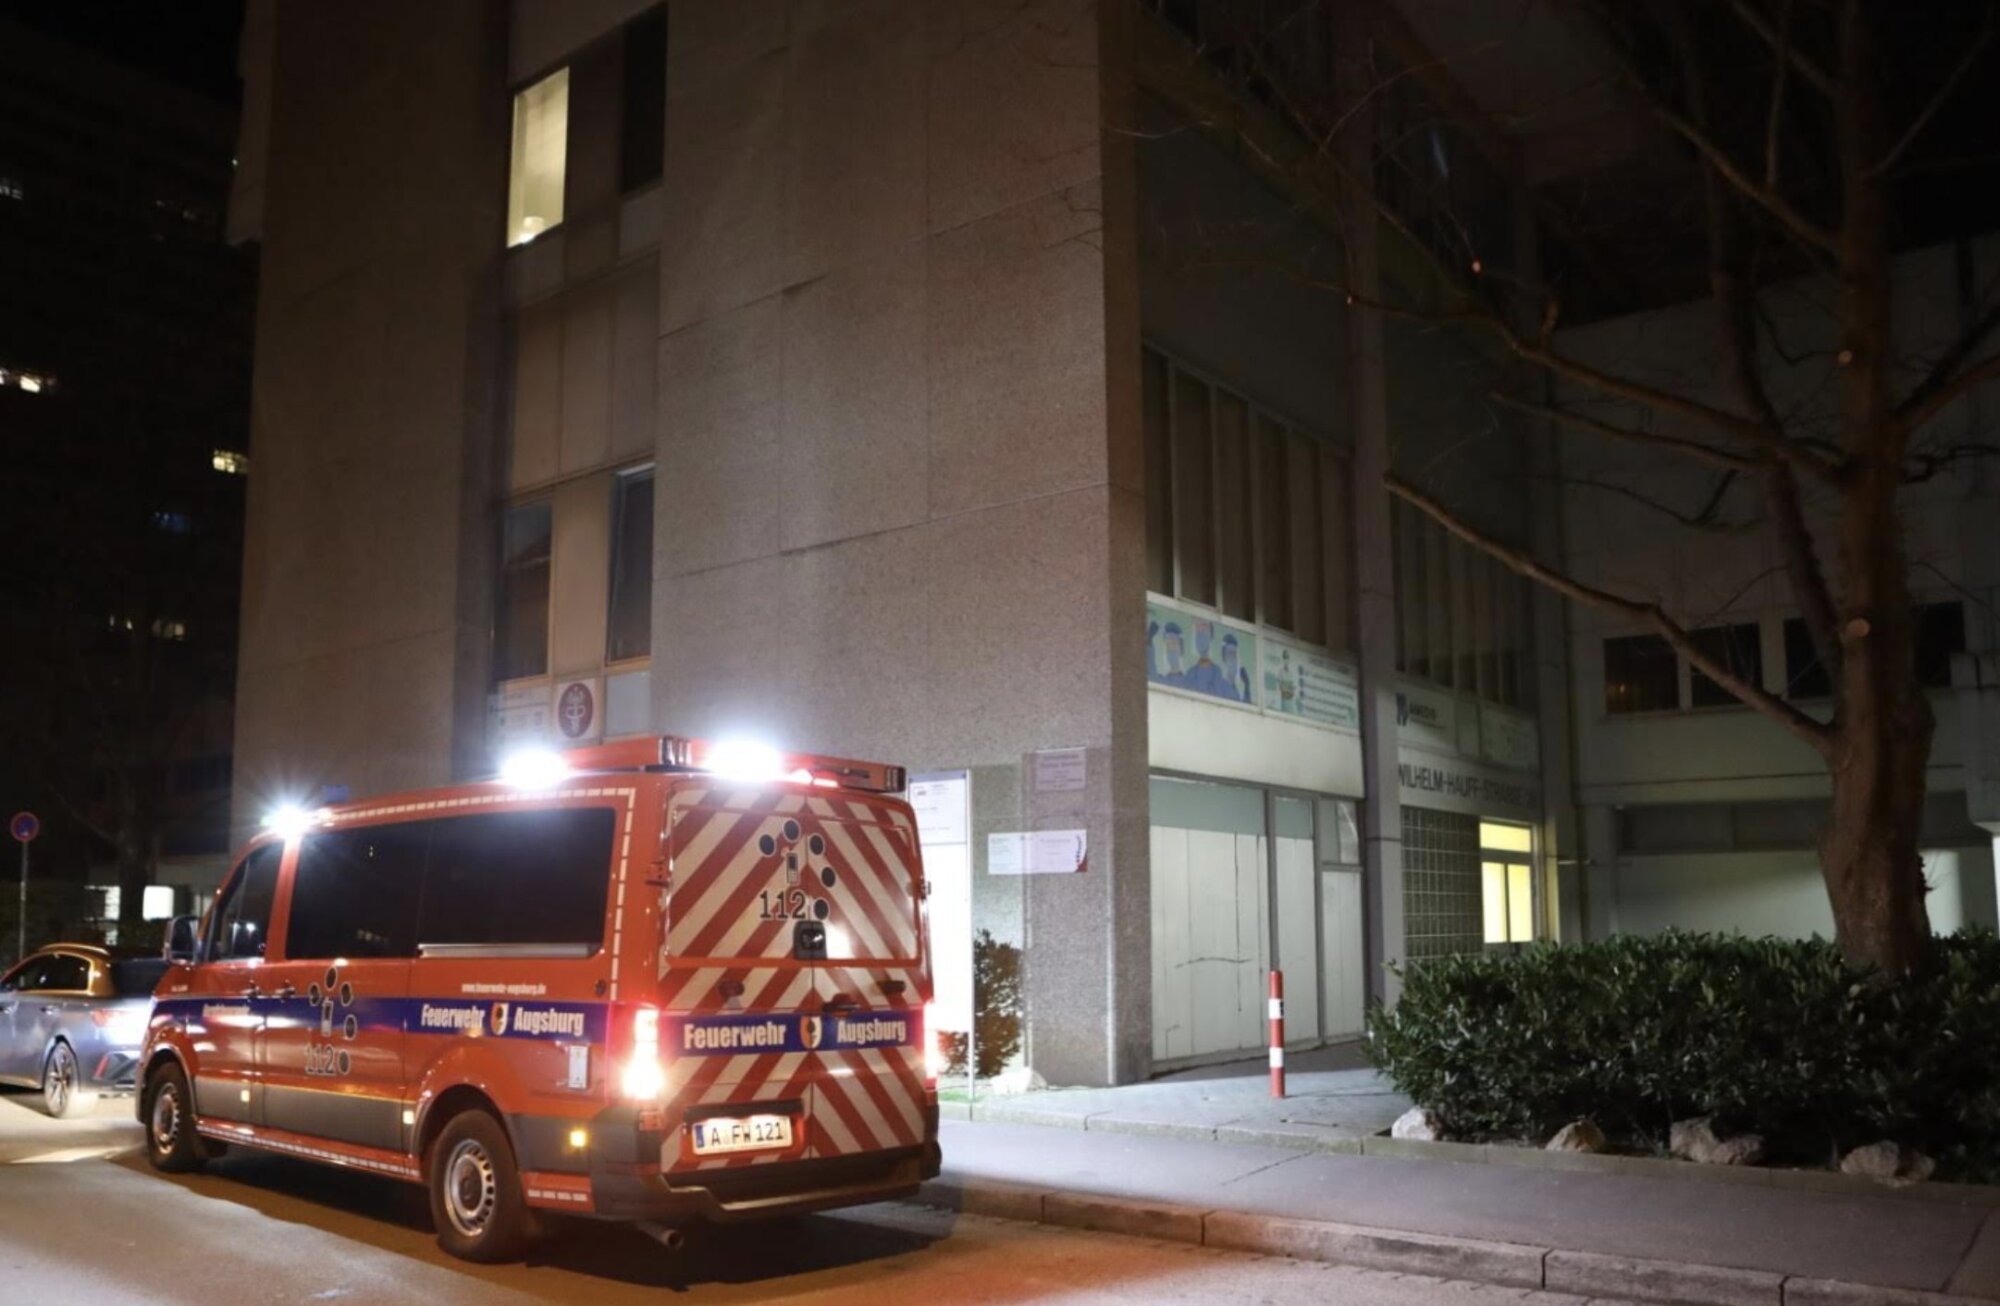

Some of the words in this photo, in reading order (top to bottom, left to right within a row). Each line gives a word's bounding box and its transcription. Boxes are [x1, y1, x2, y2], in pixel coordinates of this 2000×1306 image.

[759, 890, 806, 920] 112
[421, 1003, 485, 1029] Feuerwehr
[514, 1006, 585, 1036] Augsburg
[683, 1021, 787, 1050] Feuerwehr
[837, 1018, 907, 1044] Augsburg
[304, 1044, 336, 1076] 112
[711, 1127, 722, 1146] A
[731, 1124, 751, 1144] FW
[755, 1121, 784, 1142] 121
